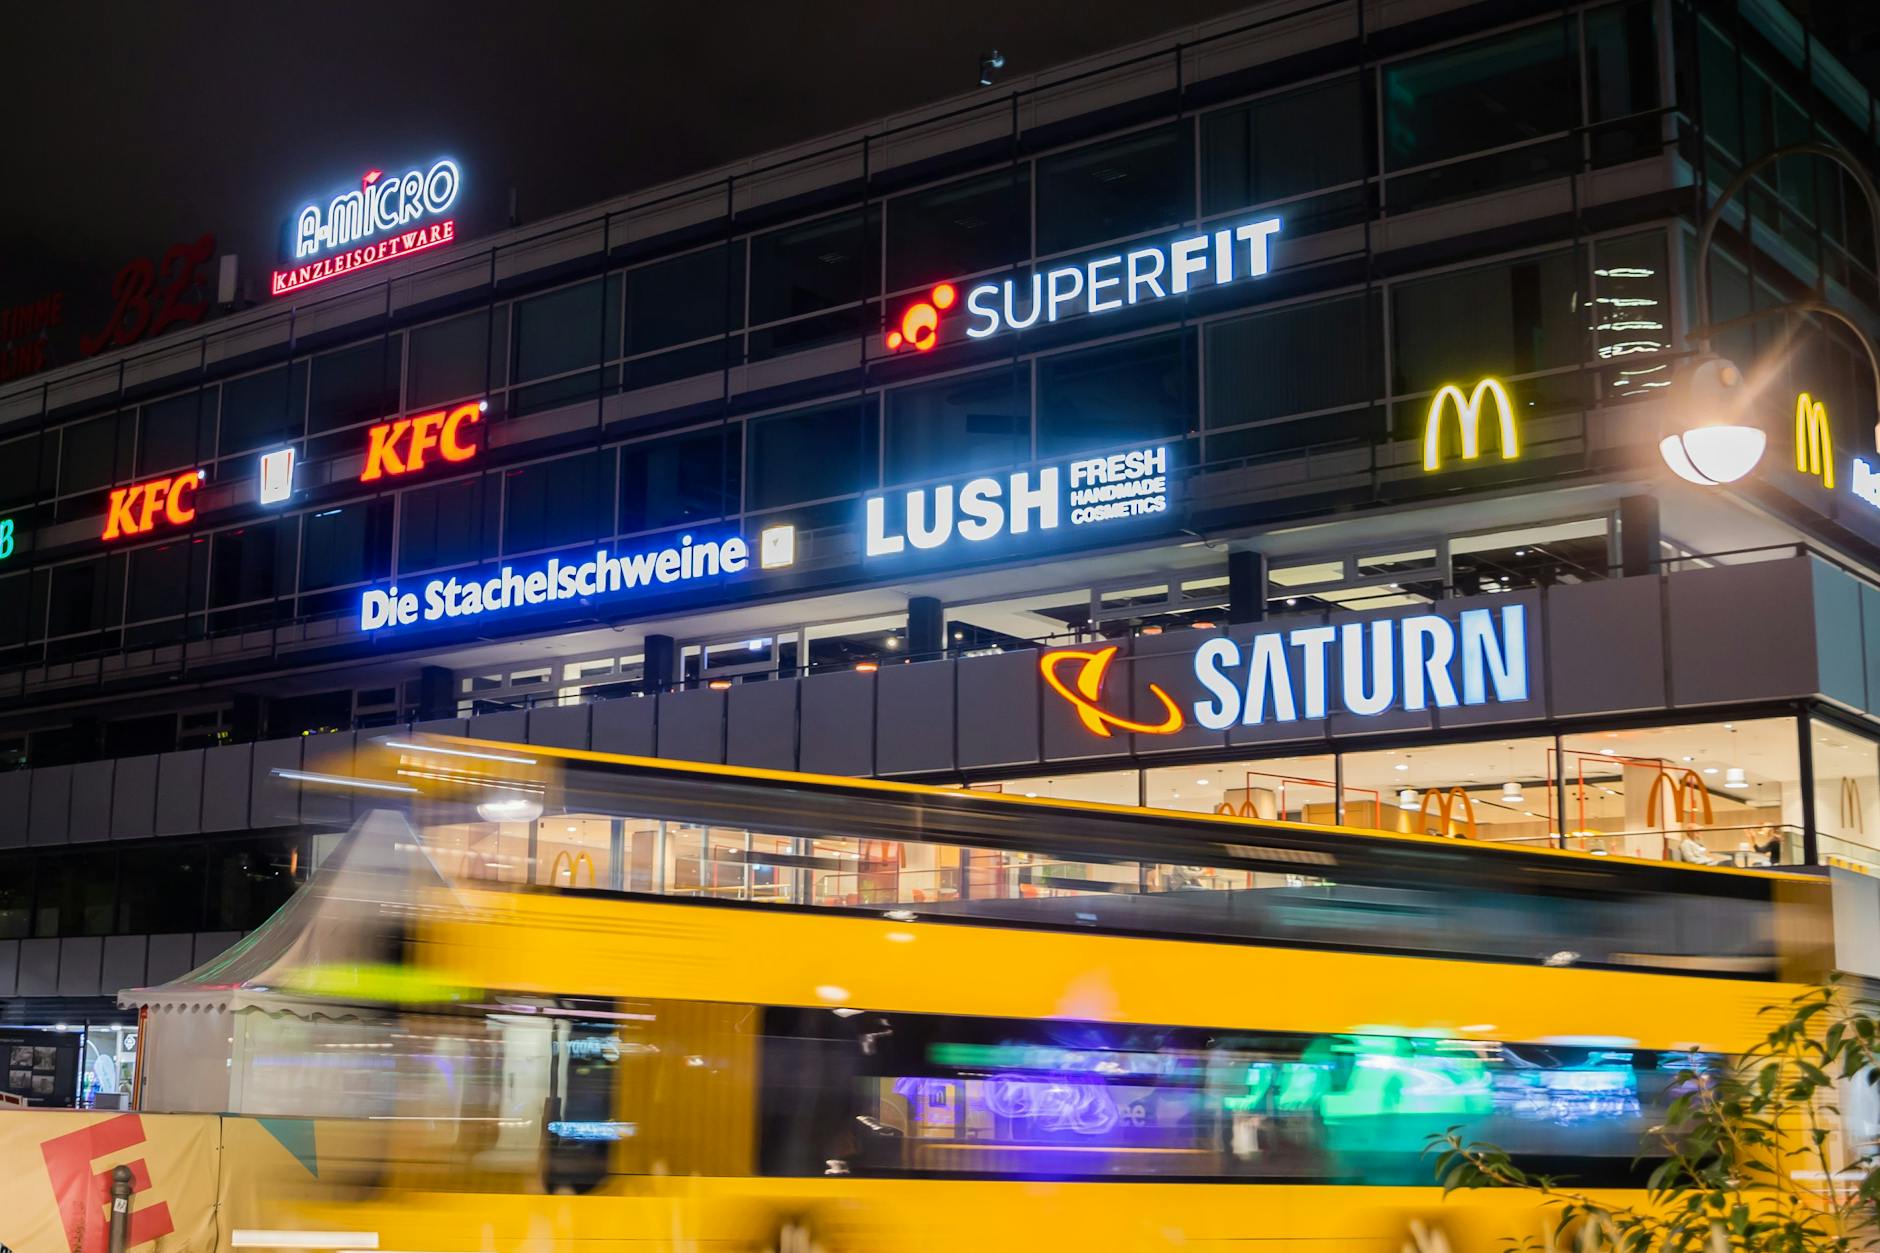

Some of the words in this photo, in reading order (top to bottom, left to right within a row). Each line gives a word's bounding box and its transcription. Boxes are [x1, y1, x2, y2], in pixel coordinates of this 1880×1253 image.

[276, 221, 455, 292] KANZLEISOFTWARE
[966, 217, 1281, 338] SUPERFIT
[1070, 447, 1166, 488] FRESH
[1070, 476, 1166, 506] HANDMADE
[867, 466, 1059, 557] LUSH
[1070, 495, 1166, 525] COSMETICS
[360, 589, 419, 631] Die
[424, 535, 749, 621] Stachelschweine
[1193, 604, 1529, 731] SATURN
